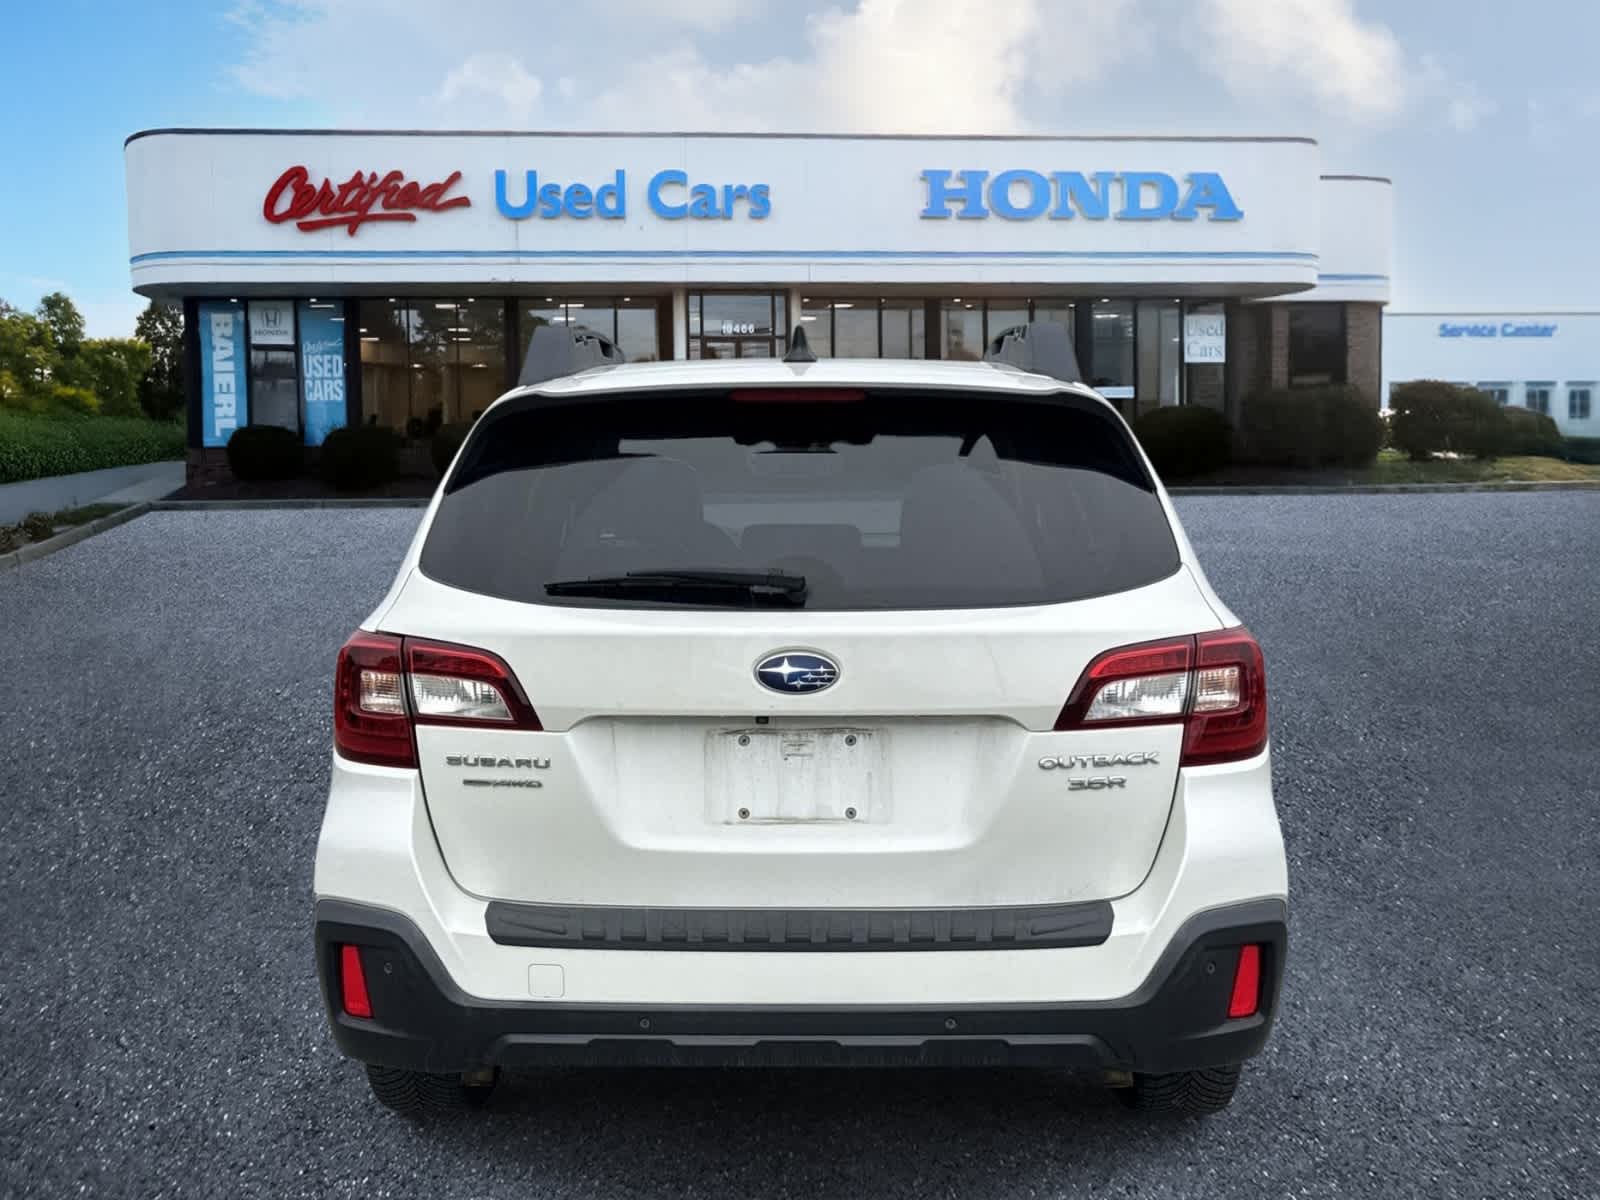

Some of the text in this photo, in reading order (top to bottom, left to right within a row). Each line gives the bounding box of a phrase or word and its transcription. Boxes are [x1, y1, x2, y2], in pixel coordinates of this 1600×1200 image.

[263, 165, 472, 237] Certified
[495, 169, 771, 221] Used Cars
[919, 169, 1245, 222] HONDA
[253, 328, 290, 337] HONDA
[1187, 319, 1224, 337] Used
[1438, 321, 1559, 338] Service Center
[1187, 341, 1223, 358] Cars
[210, 312, 238, 437] BAIERL
[303, 354, 343, 378] USED
[304, 379, 344, 402] CARS
[446, 756, 551, 769] SUBARU
[1038, 752, 1160, 771] OUTBACK
